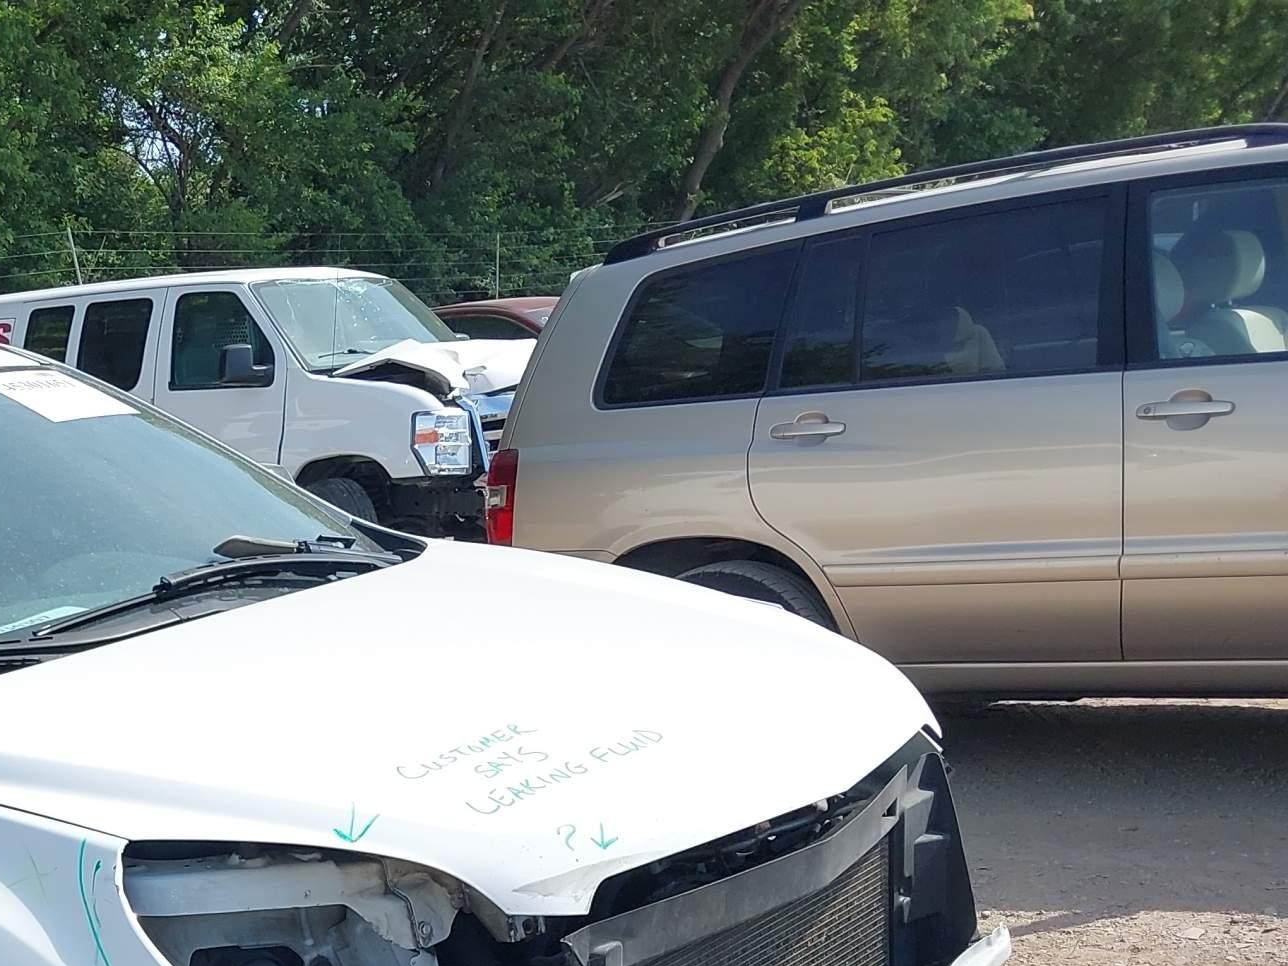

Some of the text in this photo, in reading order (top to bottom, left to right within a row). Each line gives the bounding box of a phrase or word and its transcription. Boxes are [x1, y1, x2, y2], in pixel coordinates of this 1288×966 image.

[465, 729, 664, 815] LEAKING FLUID
[473, 746, 550, 779] SAYS
